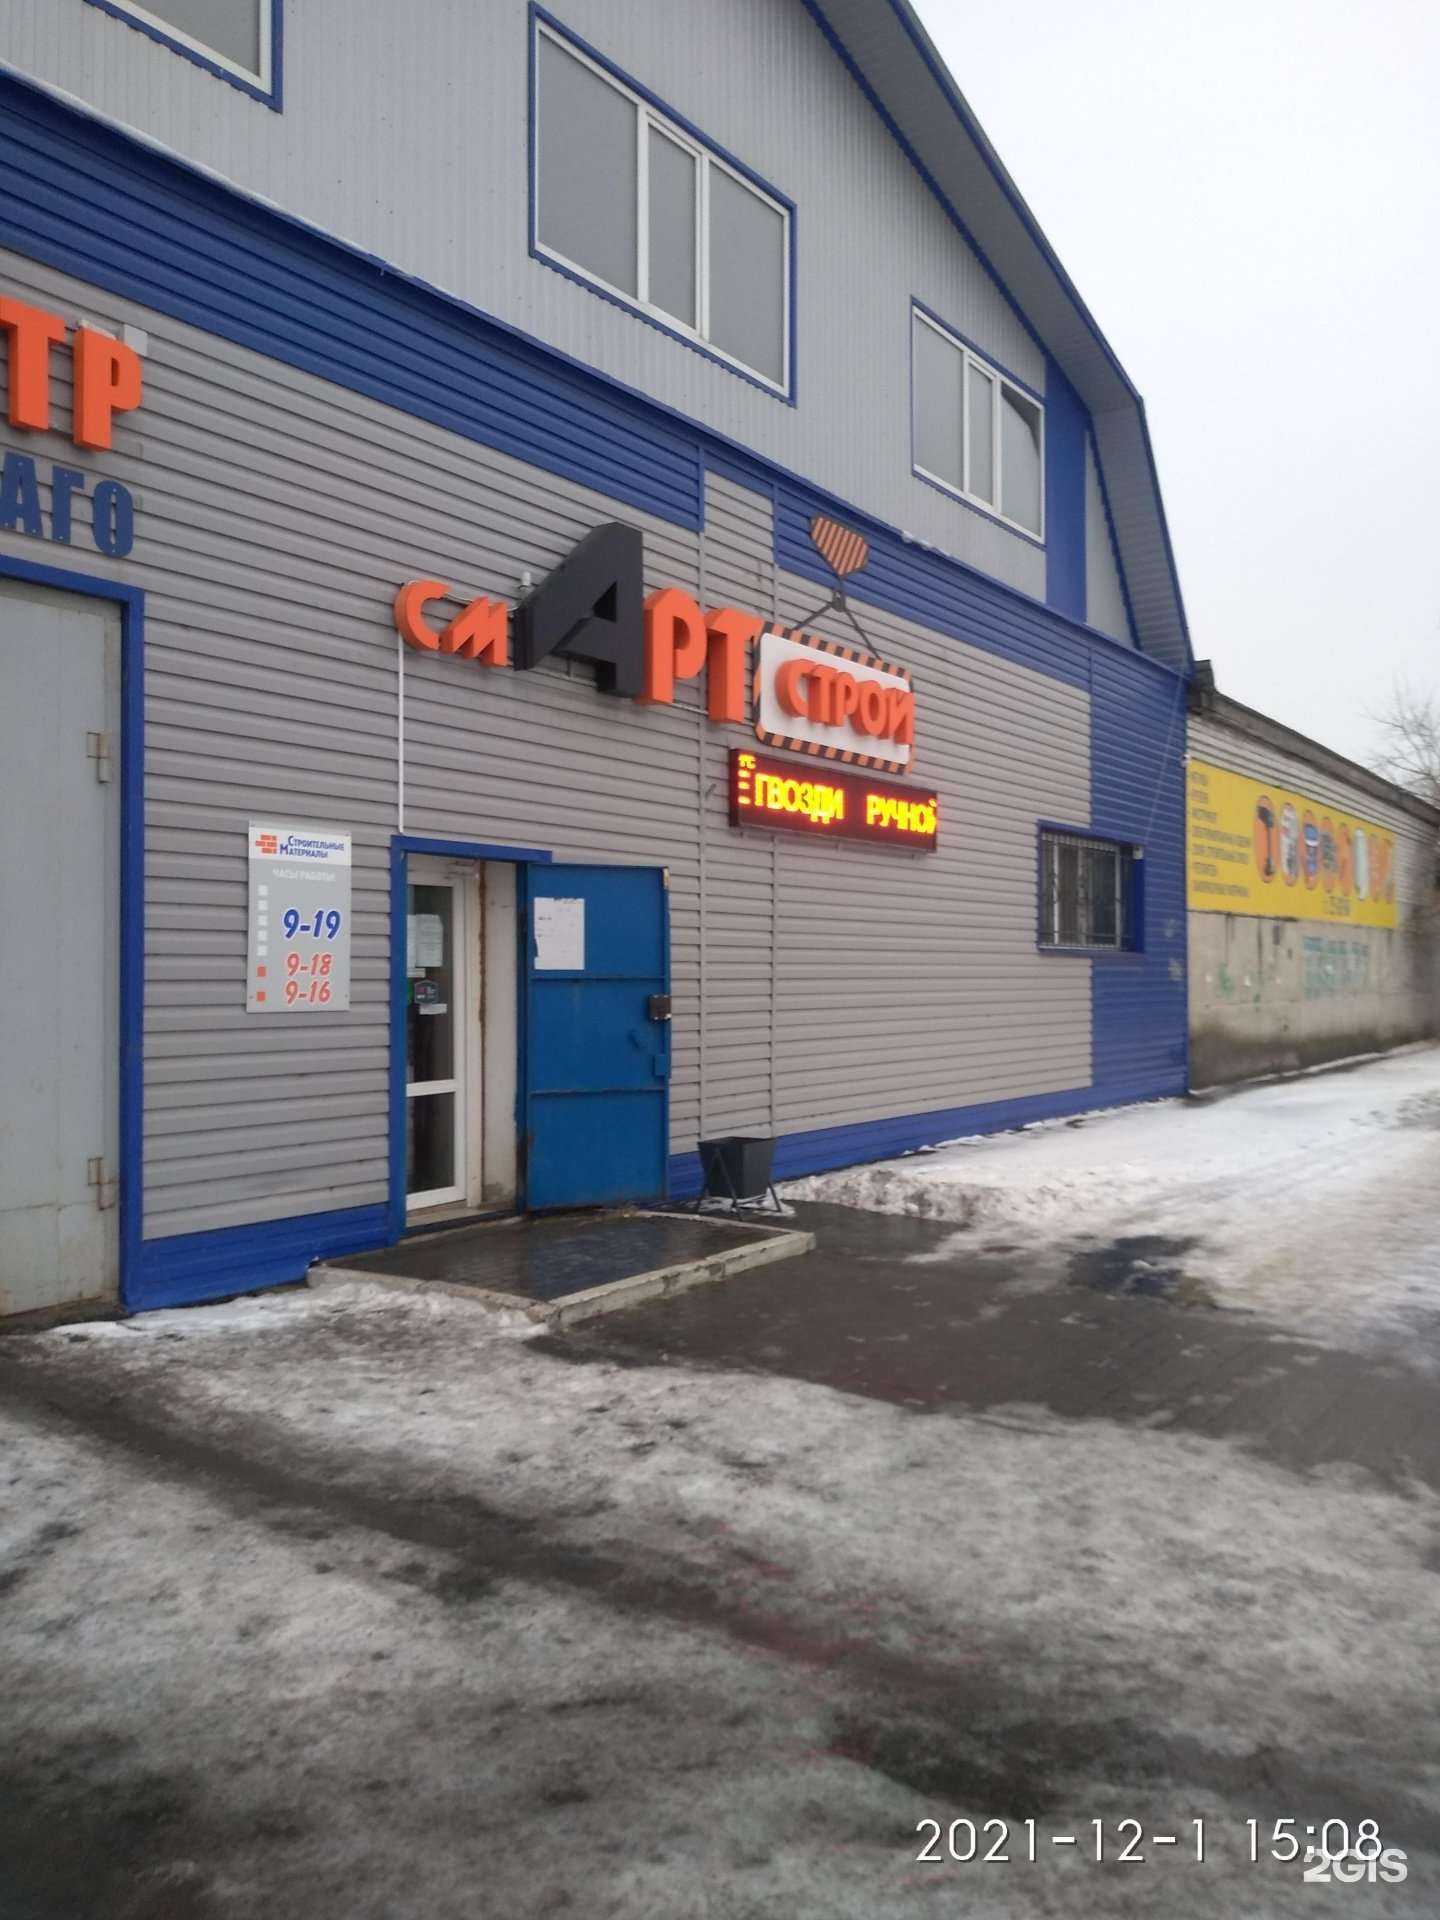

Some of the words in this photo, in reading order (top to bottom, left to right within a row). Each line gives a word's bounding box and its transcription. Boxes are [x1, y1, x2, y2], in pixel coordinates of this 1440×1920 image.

[0, 452, 134, 558] АГО
[754, 772, 845, 825] ГВОЗДИ
[283, 908, 341, 940] 9-19
[287, 953, 333, 977] 9-18
[286, 980, 331, 1005] 9-16
